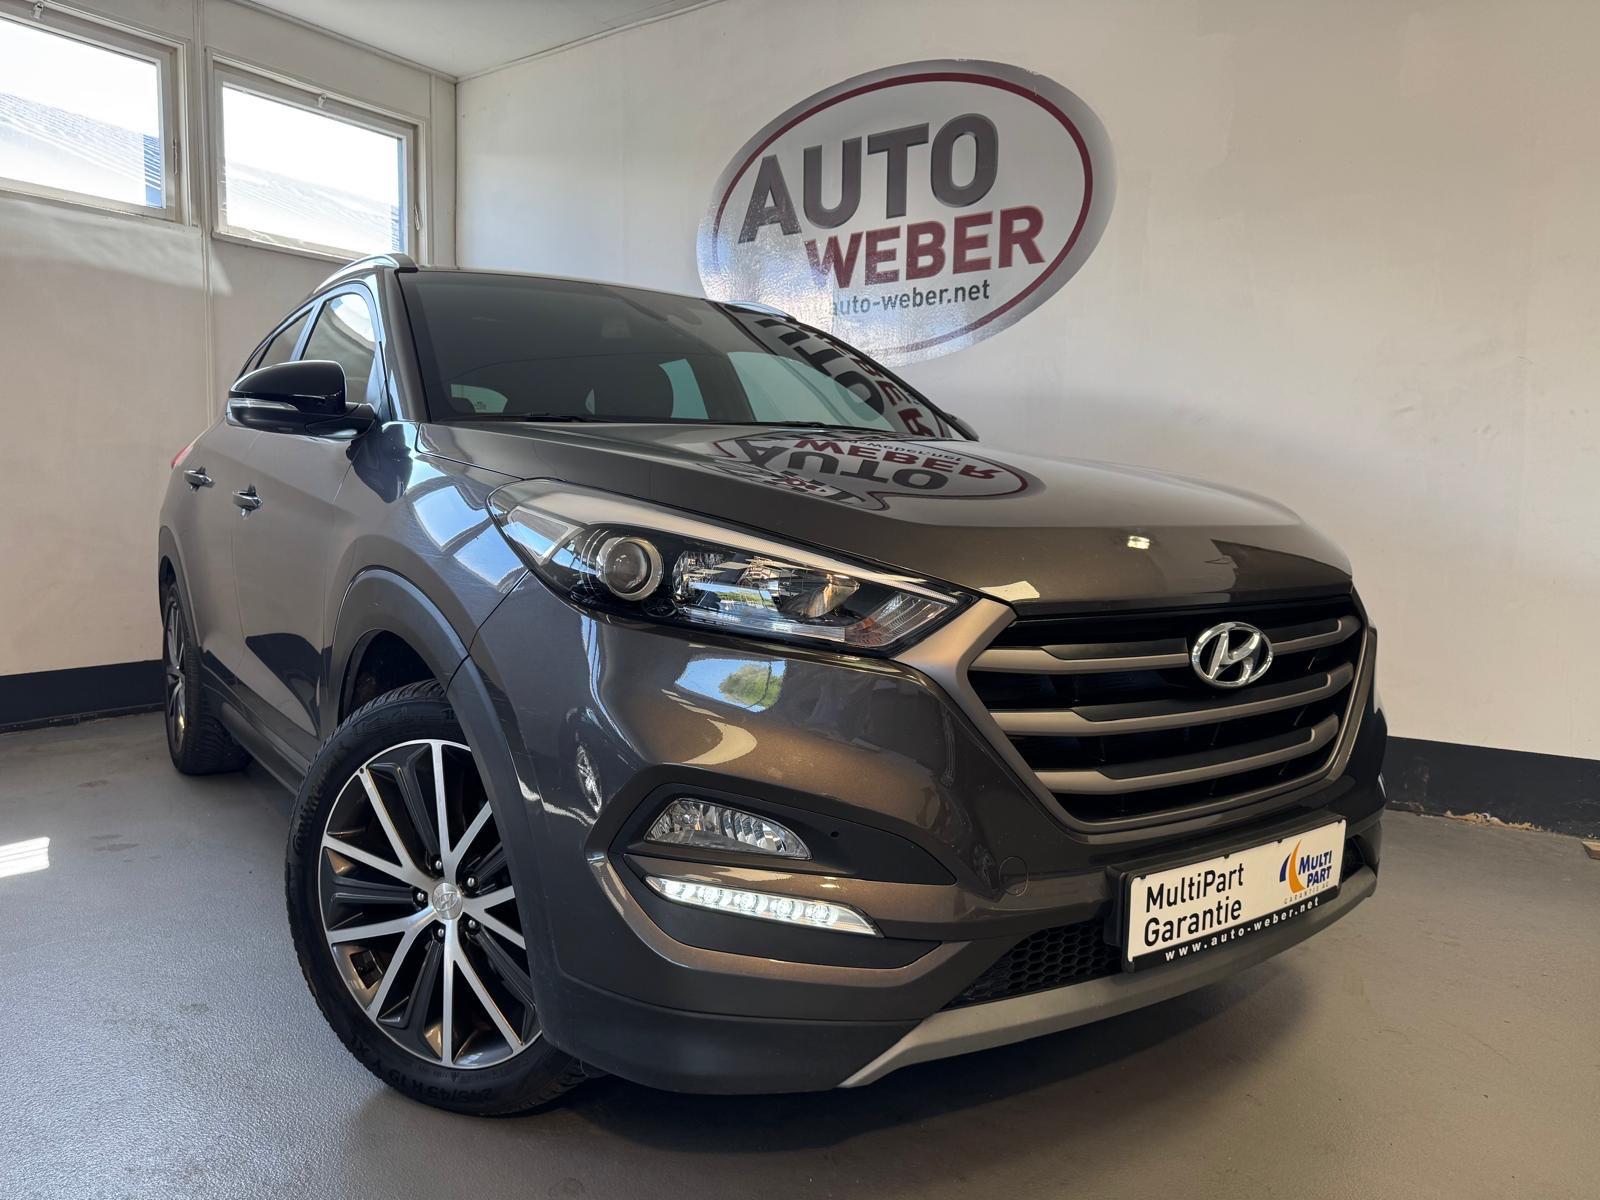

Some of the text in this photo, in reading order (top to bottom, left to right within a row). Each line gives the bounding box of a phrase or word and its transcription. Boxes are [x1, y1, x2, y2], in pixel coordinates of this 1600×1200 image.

[737, 112, 999, 244] AUTO
[804, 205, 1046, 289] WEBER
[1146, 863, 1244, 913] MultiPart
[1298, 850, 1332, 875] MULTI
[1307, 865, 1332, 888] PART
[1144, 896, 1242, 947] Garantie
[1165, 896, 1319, 962] www.auto-weber.net
